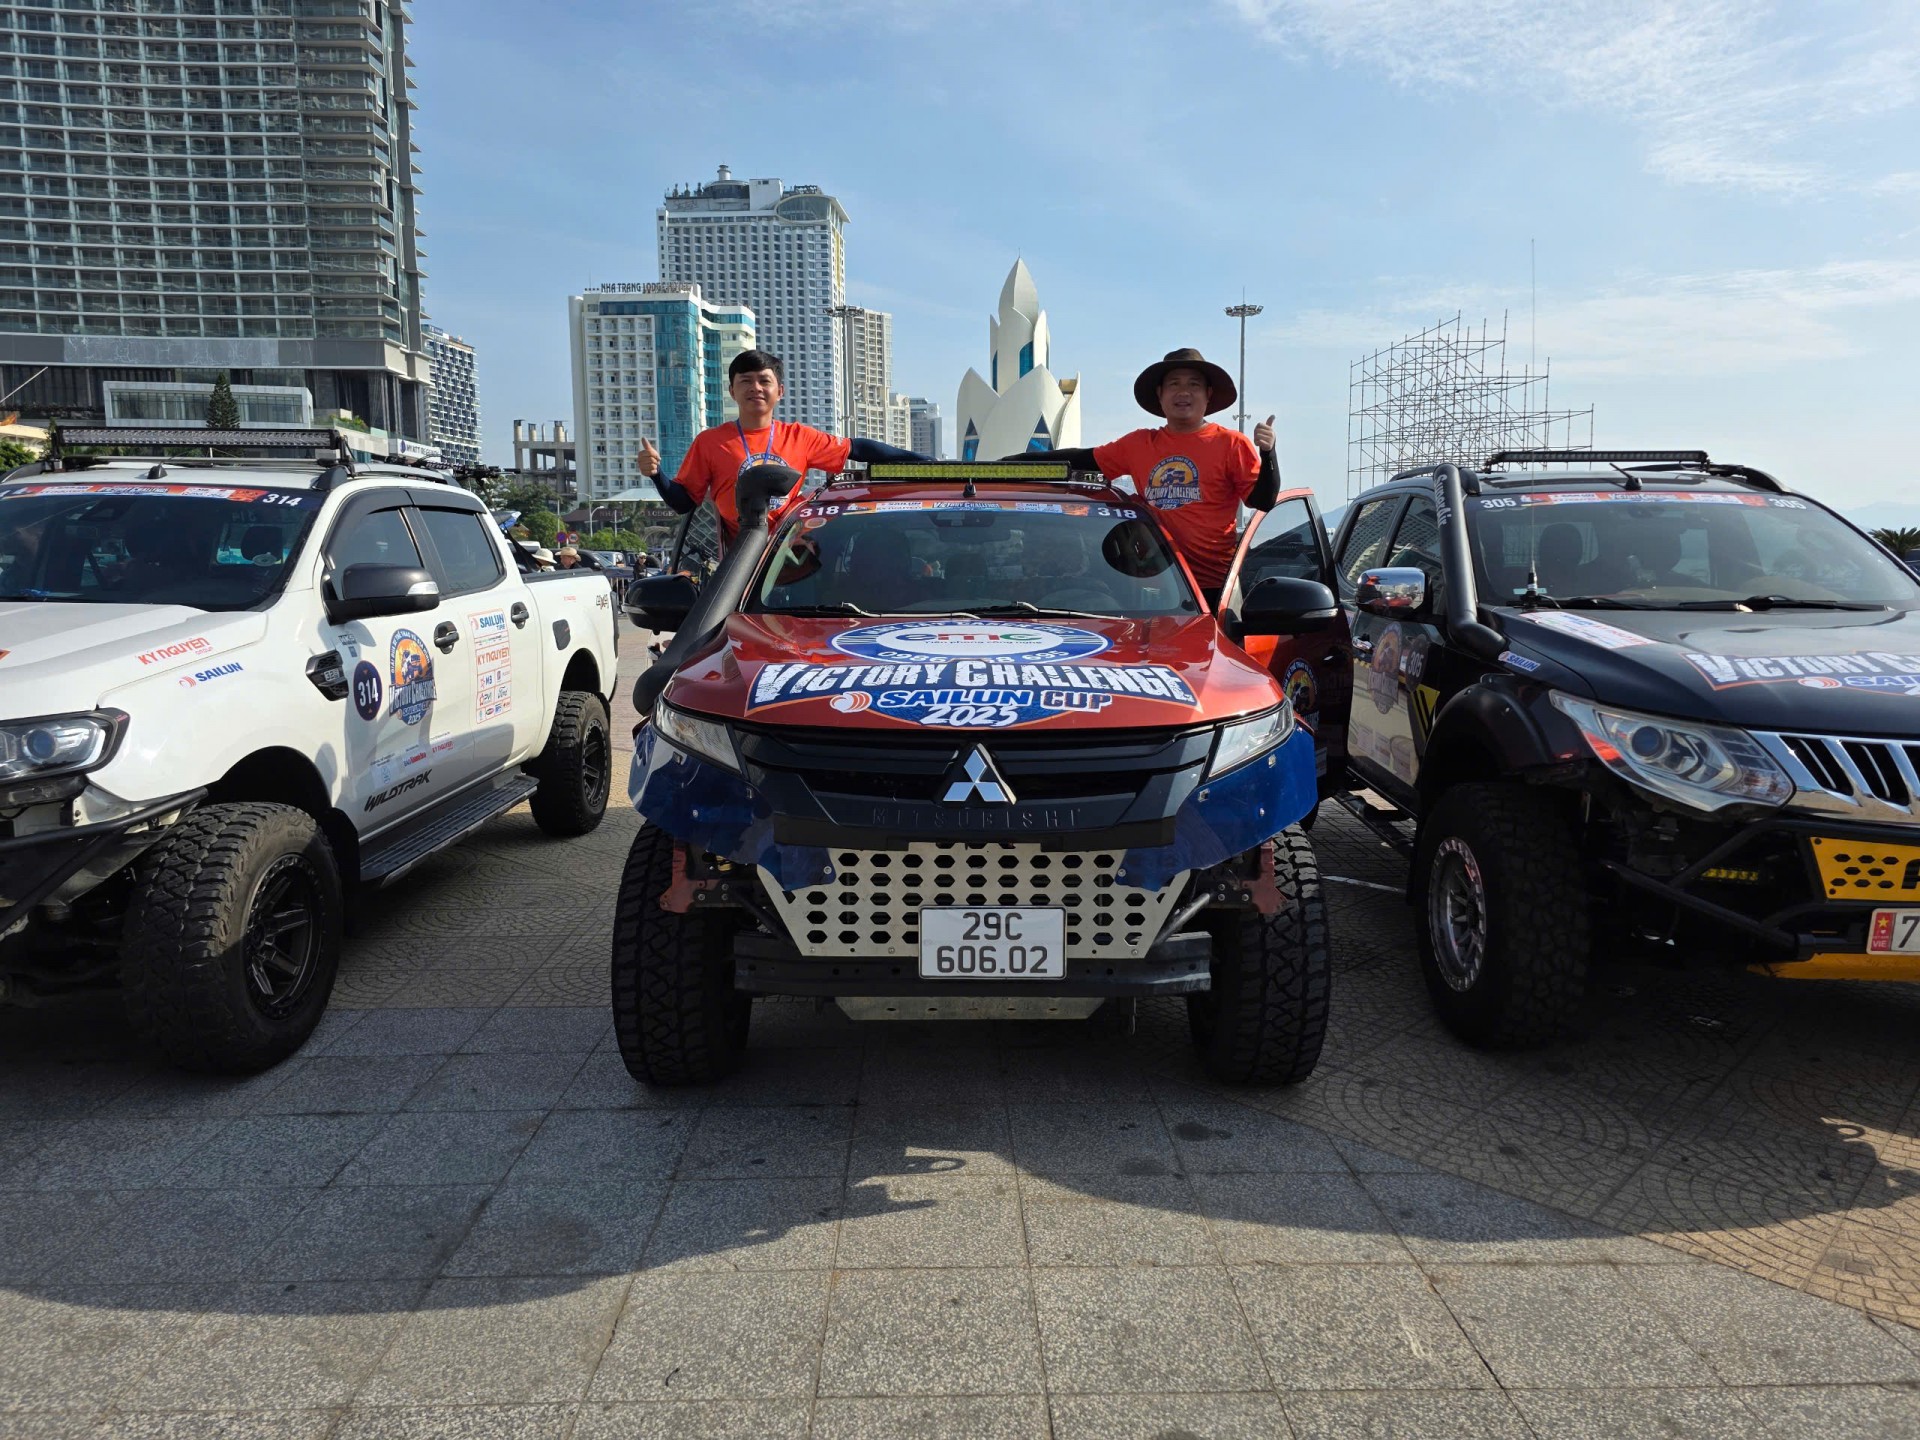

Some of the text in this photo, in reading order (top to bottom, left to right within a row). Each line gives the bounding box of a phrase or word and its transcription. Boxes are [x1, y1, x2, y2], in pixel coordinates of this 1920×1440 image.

[601, 283, 616, 293] NHA
[617, 283, 641, 293] TRANG
[642, 283, 666, 294] LODGE
[262, 492, 303, 507] 314
[1480, 498, 1517, 509] 305
[1769, 498, 1807, 510] 305
[799, 504, 840, 518] 318
[1097, 507, 1138, 519] 318
[480, 613, 505, 628] SAILUN
[877, 651, 947, 663] 0986
[1021, 650, 1070, 661] 695
[1408, 651, 1425, 678] 305
[1506, 654, 1539, 672] SAILUN
[195, 662, 244, 682] SAILUN
[1686, 653, 1884, 683] VICTORY
[754, 659, 1196, 704] VICTORY CHALLENGE
[357, 677, 379, 707] 314
[877, 689, 1113, 713] SAILUN CUP
[919, 703, 1019, 727] 2025
[363, 768, 433, 812] WILDTRAK
[872, 806, 1082, 829] MITSUBISHI
[962, 911, 1023, 941] 29C
[1871, 940, 1888, 948] VIE
[936, 945, 1048, 974] 606.02
